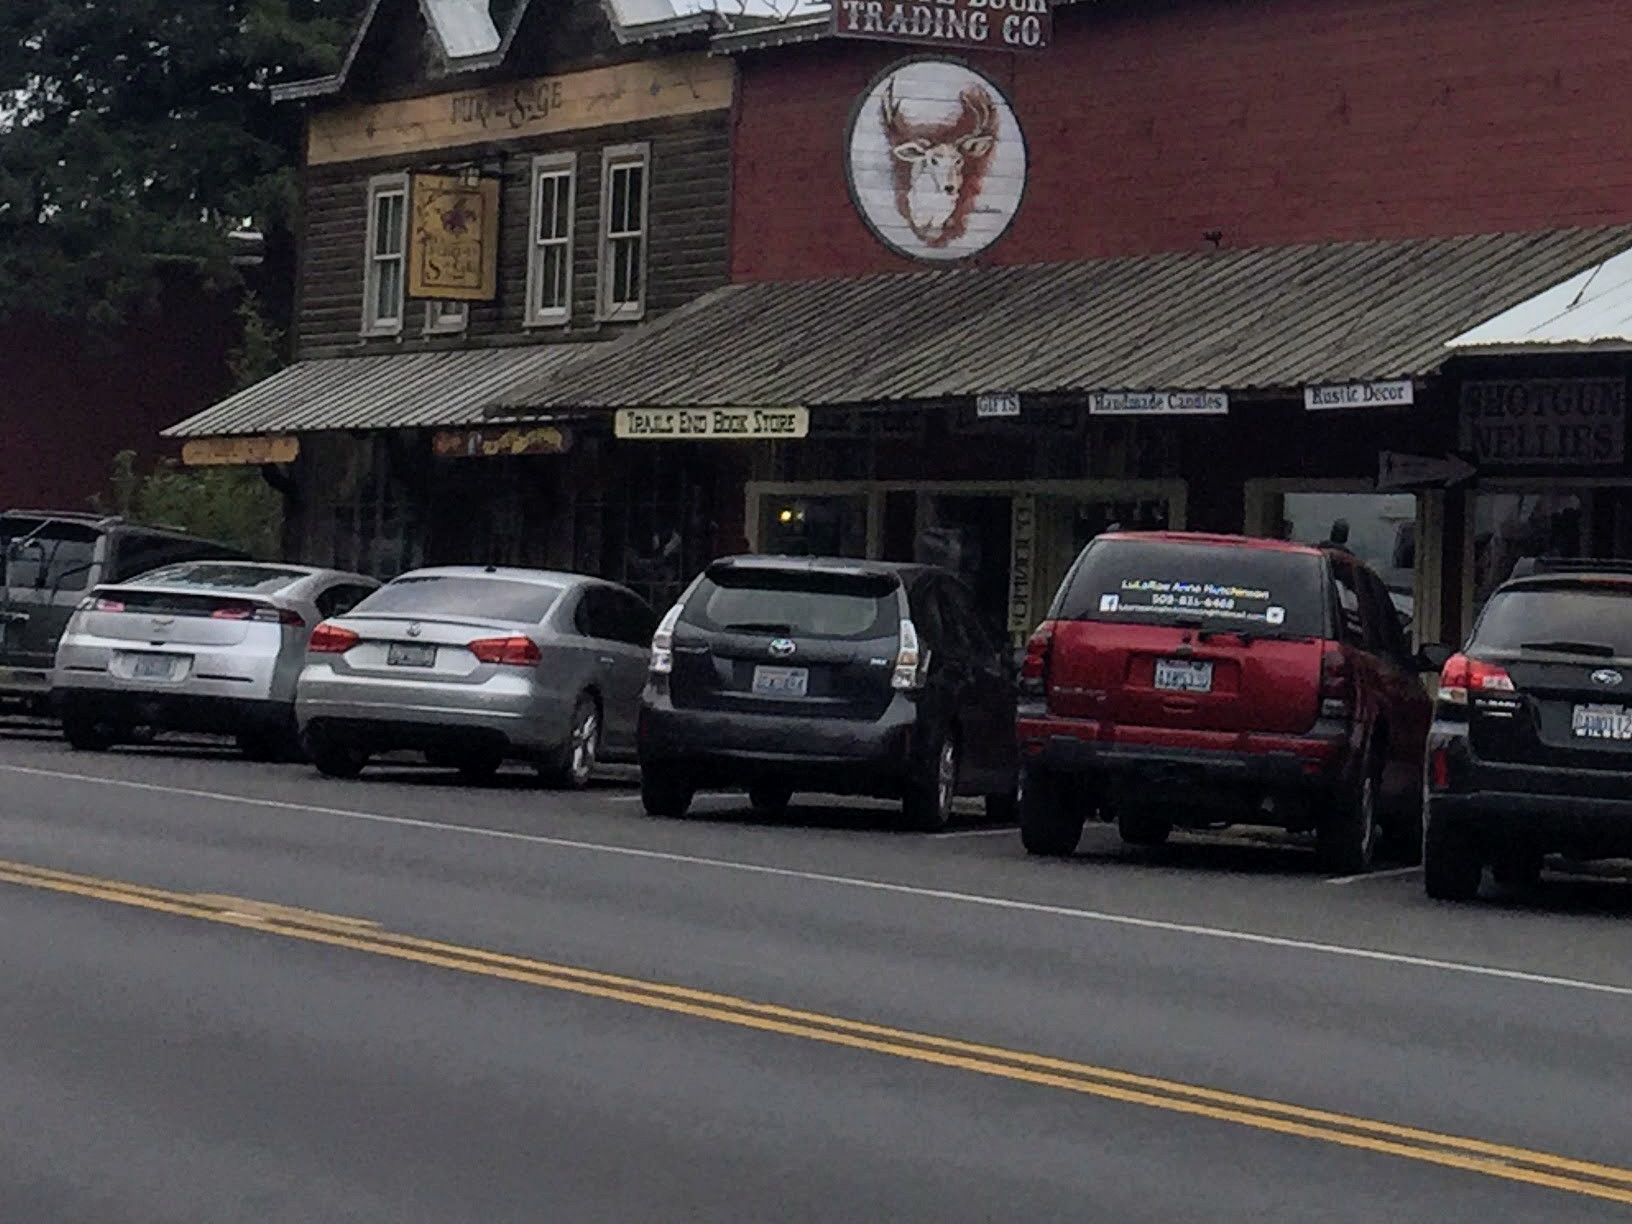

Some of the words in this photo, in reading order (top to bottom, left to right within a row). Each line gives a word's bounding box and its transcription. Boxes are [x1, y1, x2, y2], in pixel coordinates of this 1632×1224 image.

[842, 0, 989, 41] TRADING
[979, 396, 1017, 412] GIFTS
[1094, 392, 1164, 410] Handmade
[1312, 385, 1357, 404] Rustic
[1363, 383, 1404, 402] Decor
[1463, 382, 1623, 417] SHOTGUN
